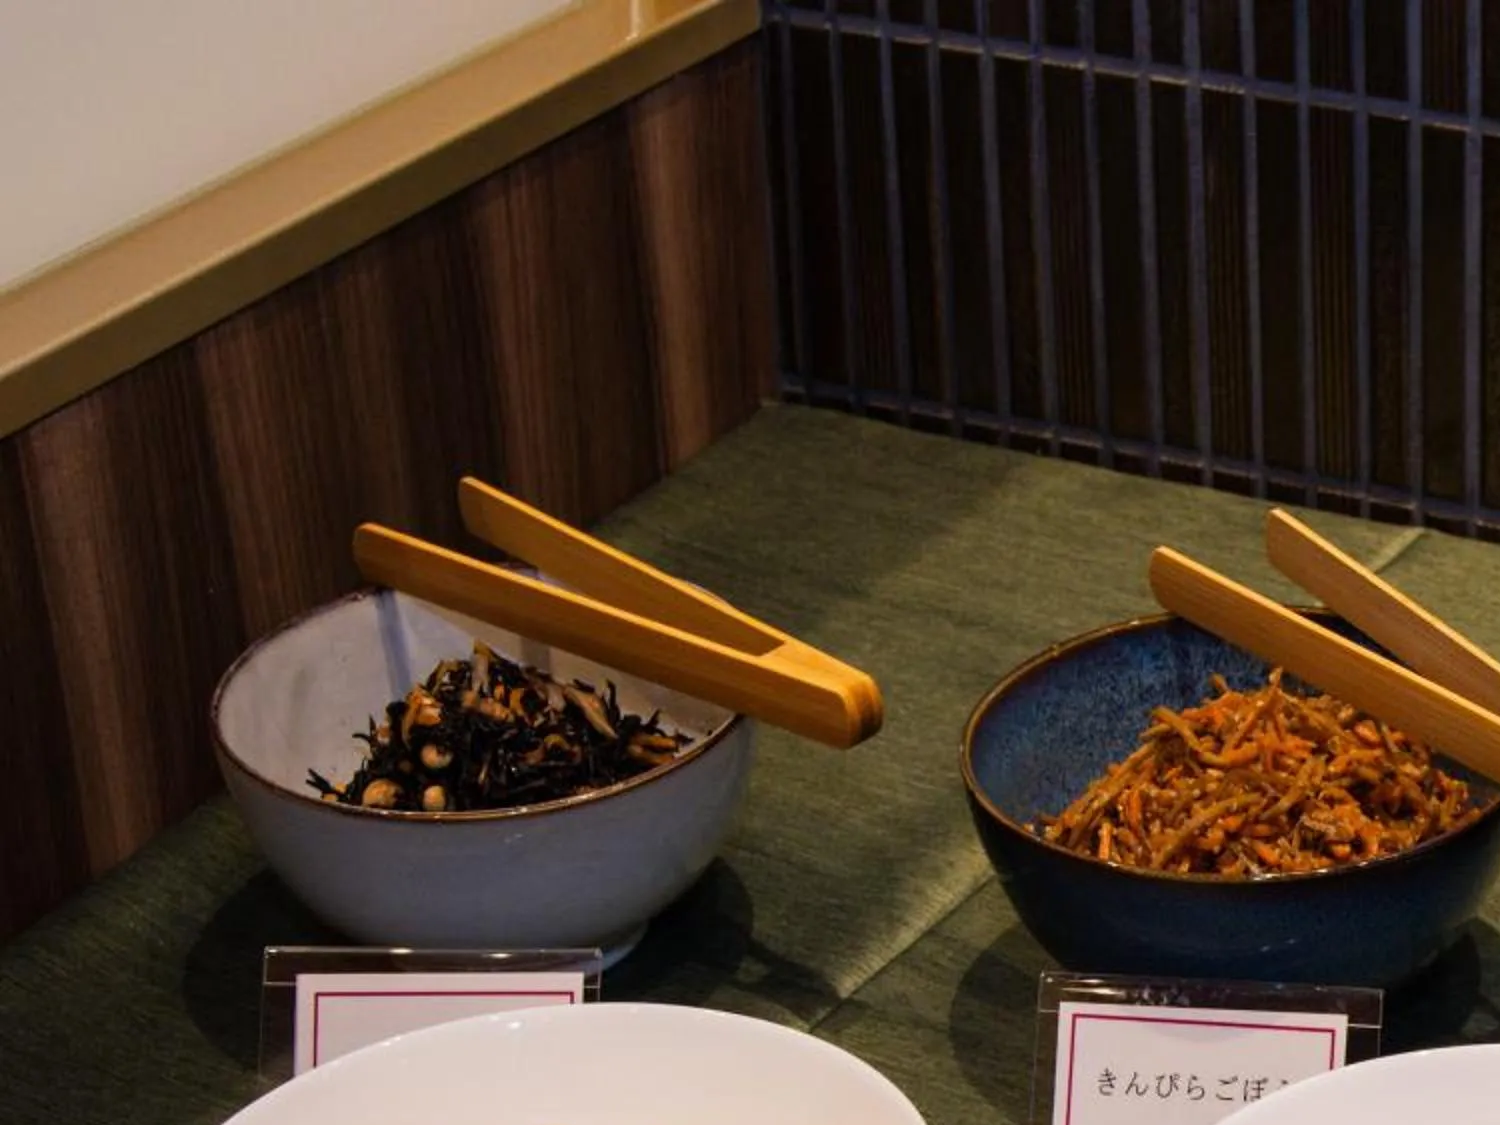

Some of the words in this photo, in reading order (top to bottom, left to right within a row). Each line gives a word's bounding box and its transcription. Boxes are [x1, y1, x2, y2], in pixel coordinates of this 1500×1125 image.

[1097, 1067, 1292, 1103] きんぴらごぼ
